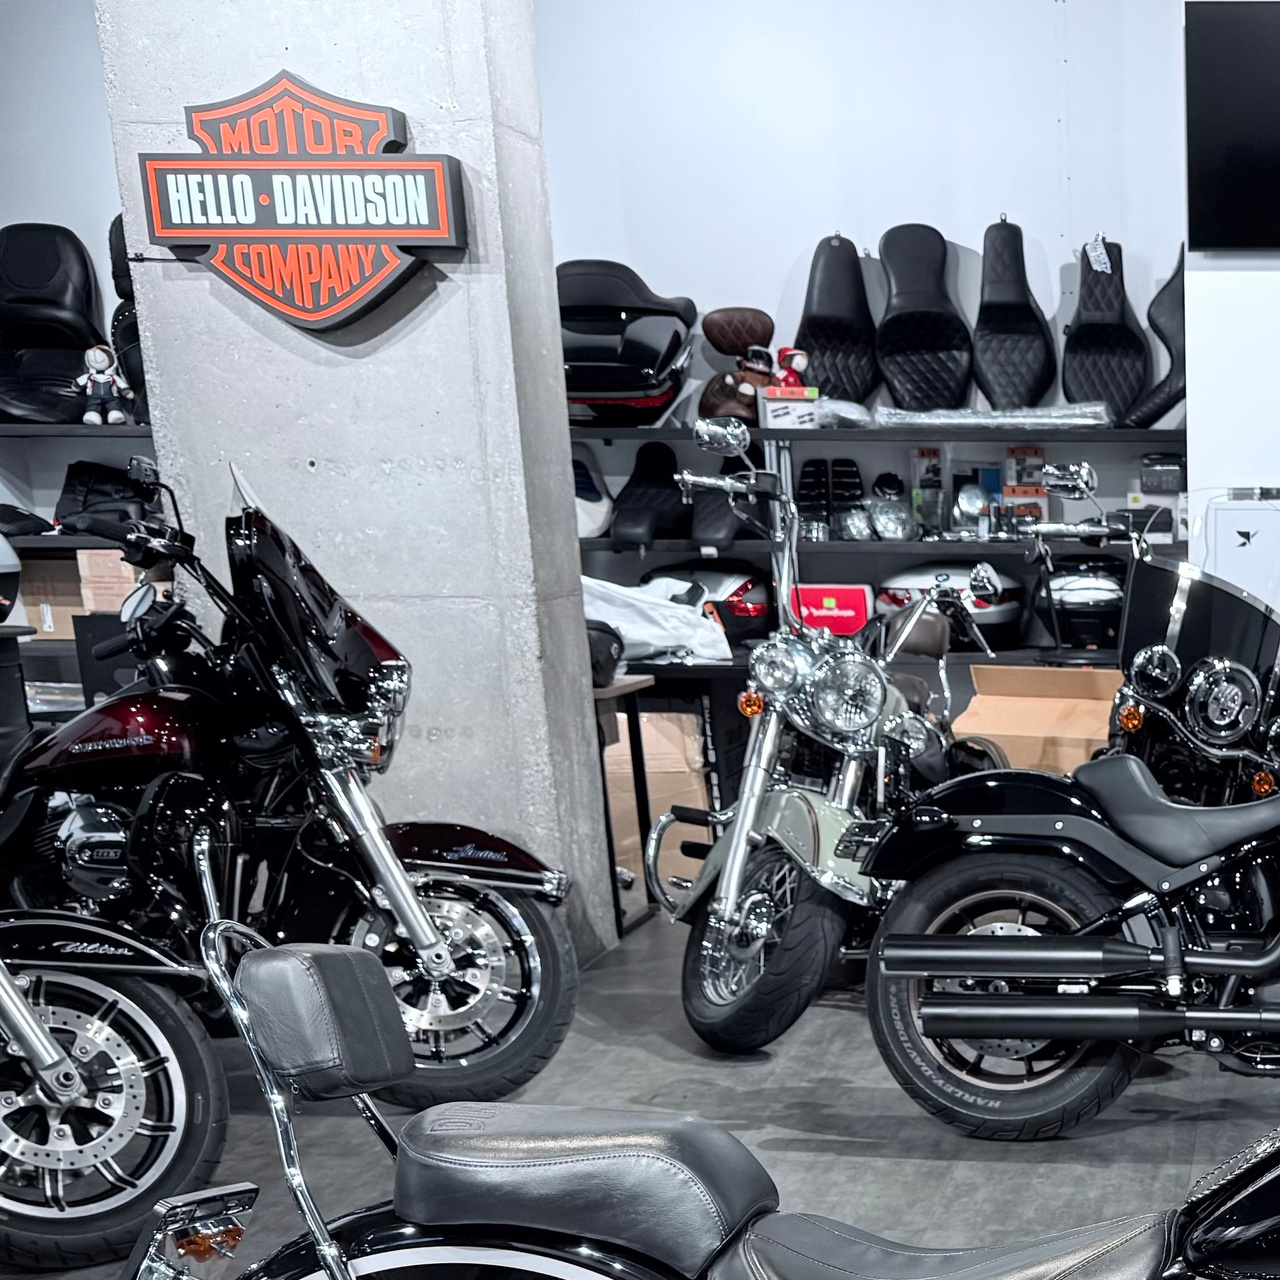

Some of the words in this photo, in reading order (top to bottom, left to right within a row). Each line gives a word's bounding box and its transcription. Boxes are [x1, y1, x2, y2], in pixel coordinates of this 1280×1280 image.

[220, 95, 364, 154] MOTOR
[166, 174, 256, 225] HELLO
[272, 174, 429, 225] DAVIDSON
[233, 244, 376, 308] COMPANY
